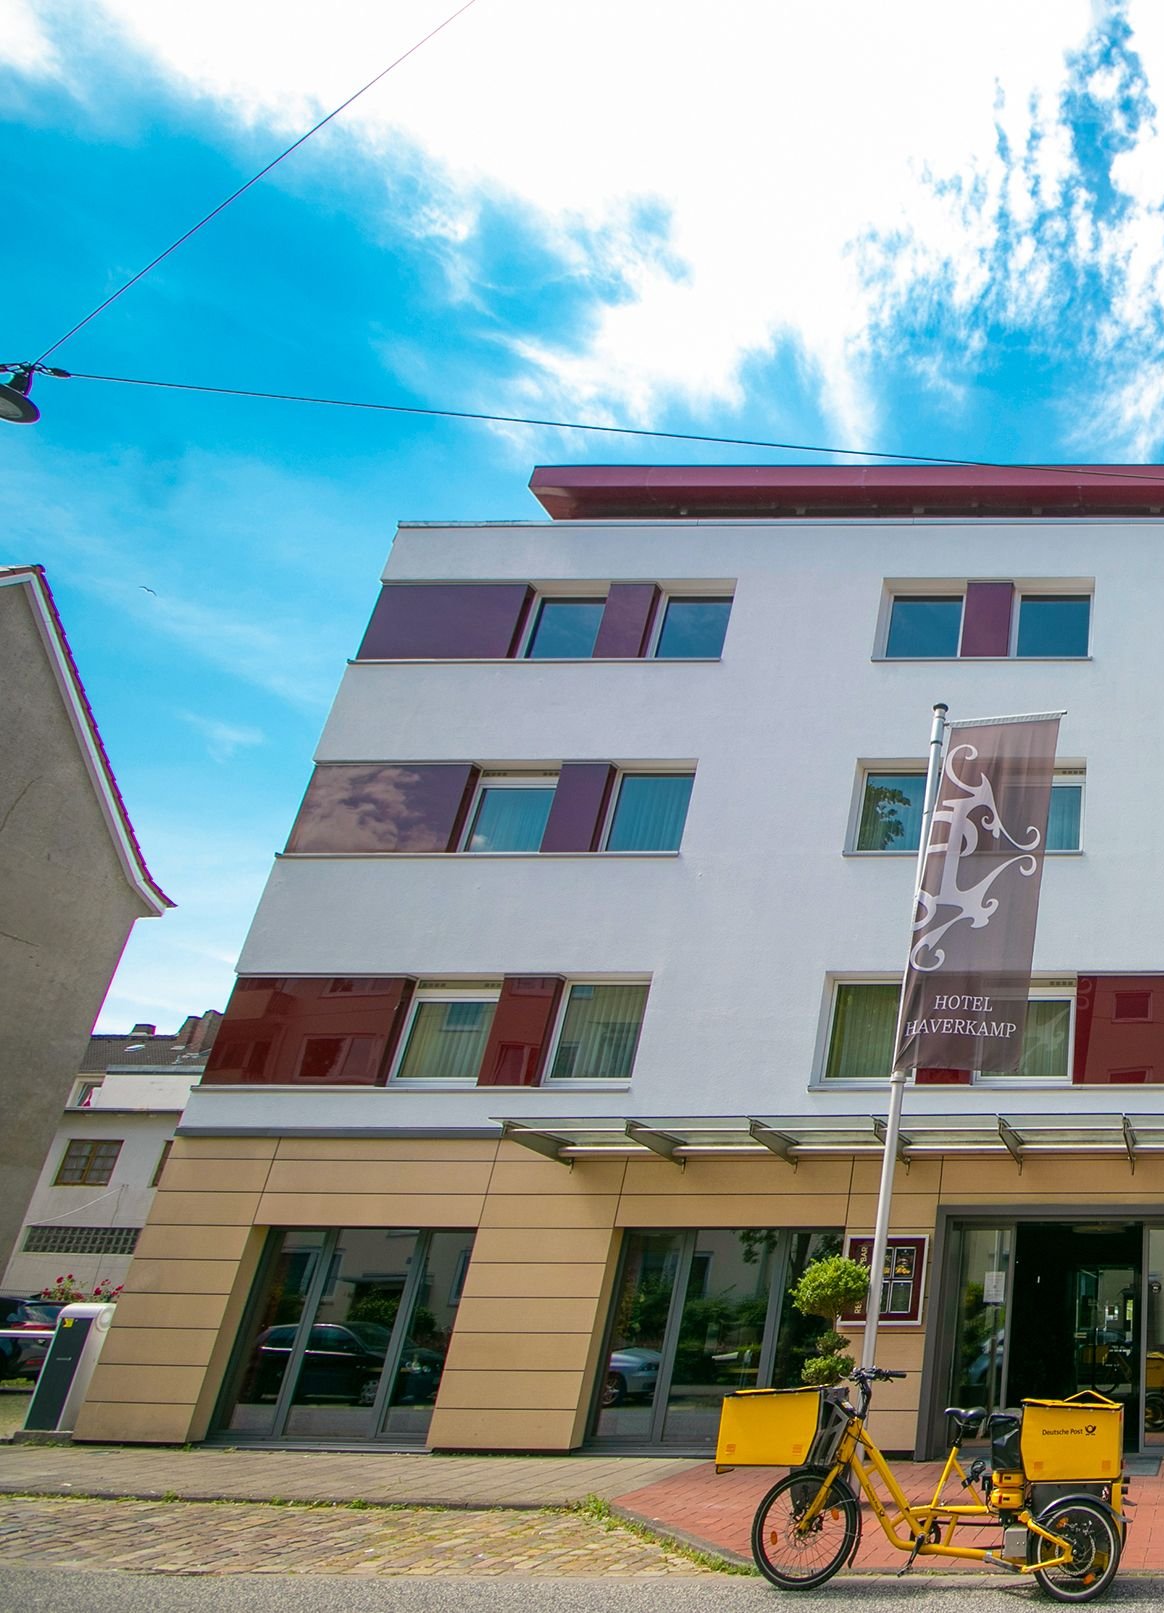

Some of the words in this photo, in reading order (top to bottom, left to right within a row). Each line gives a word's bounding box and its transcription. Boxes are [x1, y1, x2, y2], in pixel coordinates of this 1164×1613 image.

[933, 994, 993, 1012] HOTEL
[904, 1018, 1017, 1038] HAVERKAMP
[1042, 1428, 1069, 1436] Deutsche
